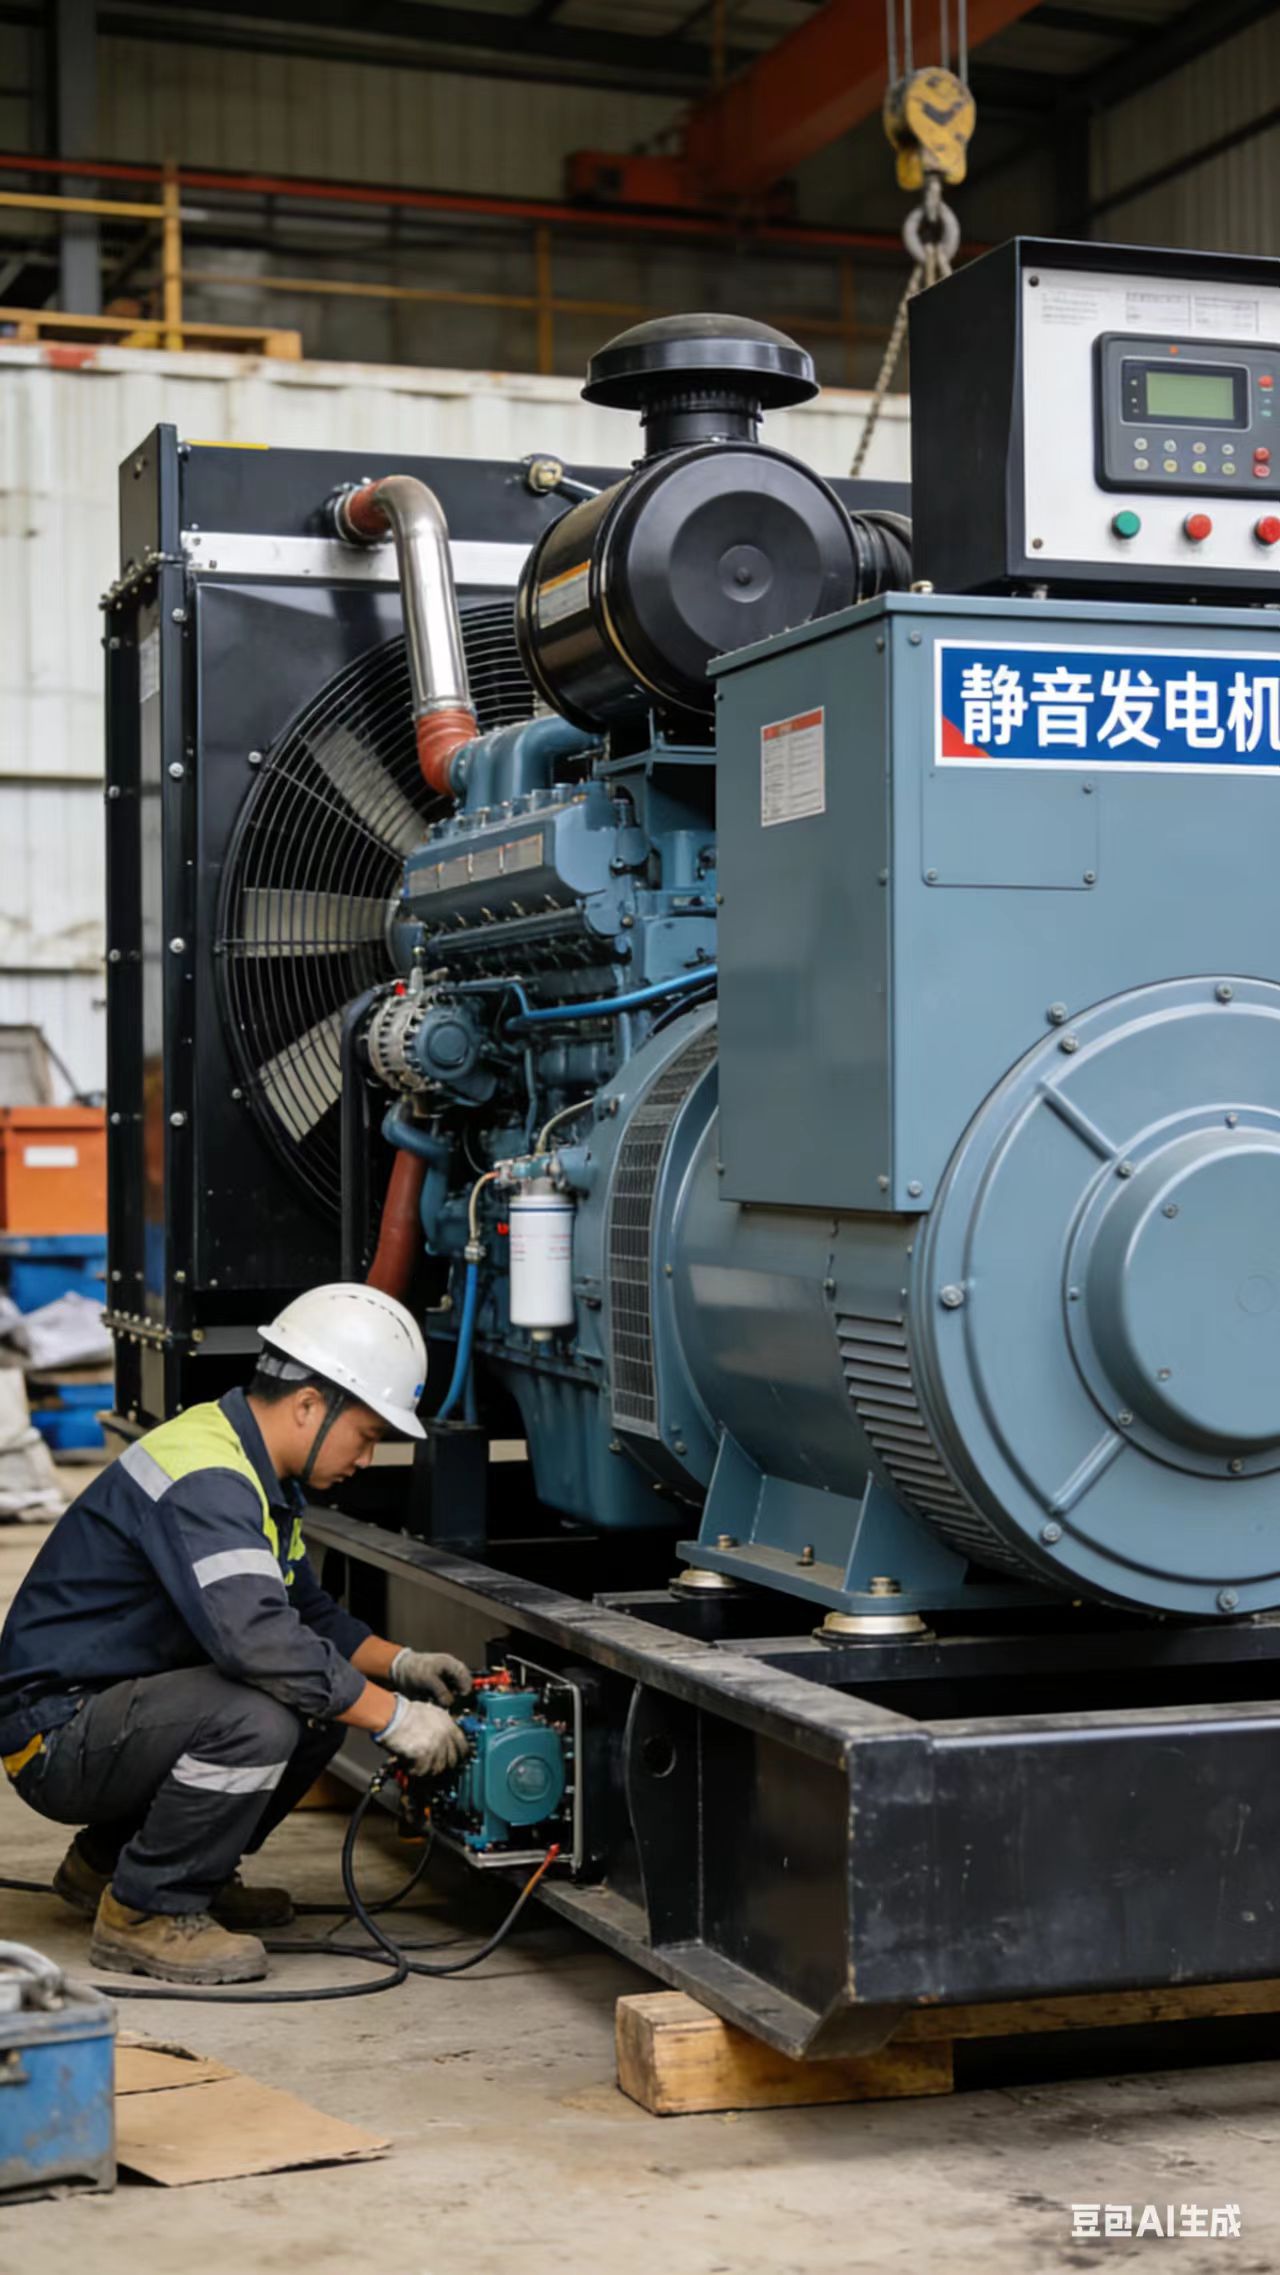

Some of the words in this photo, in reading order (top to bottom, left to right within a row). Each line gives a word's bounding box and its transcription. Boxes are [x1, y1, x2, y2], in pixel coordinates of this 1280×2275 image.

[960, 663, 1280, 752] 静音发电机
